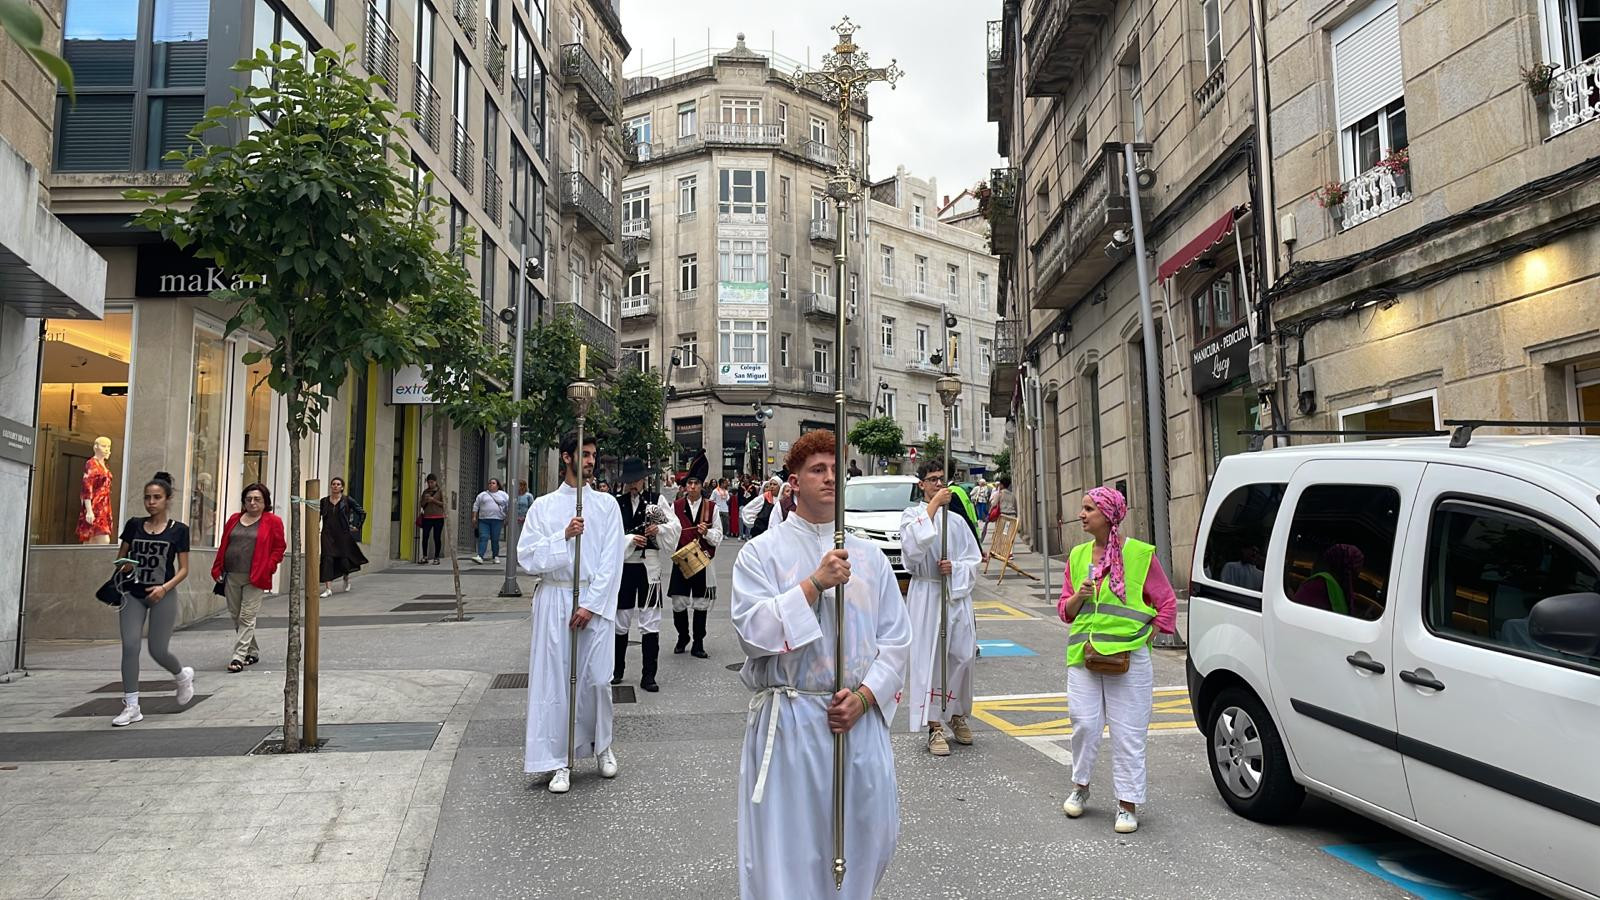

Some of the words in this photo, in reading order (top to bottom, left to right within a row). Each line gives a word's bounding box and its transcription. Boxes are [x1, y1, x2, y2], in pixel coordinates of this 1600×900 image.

[1193, 341, 1220, 365] MANICURA
[1222, 325, 1249, 349] PEDICURA
[1212, 354, 1230, 380] Lucy
[746, 372, 767, 380] Miguel
[134, 541, 168, 556] JUST
[138, 556, 160, 569] DO
